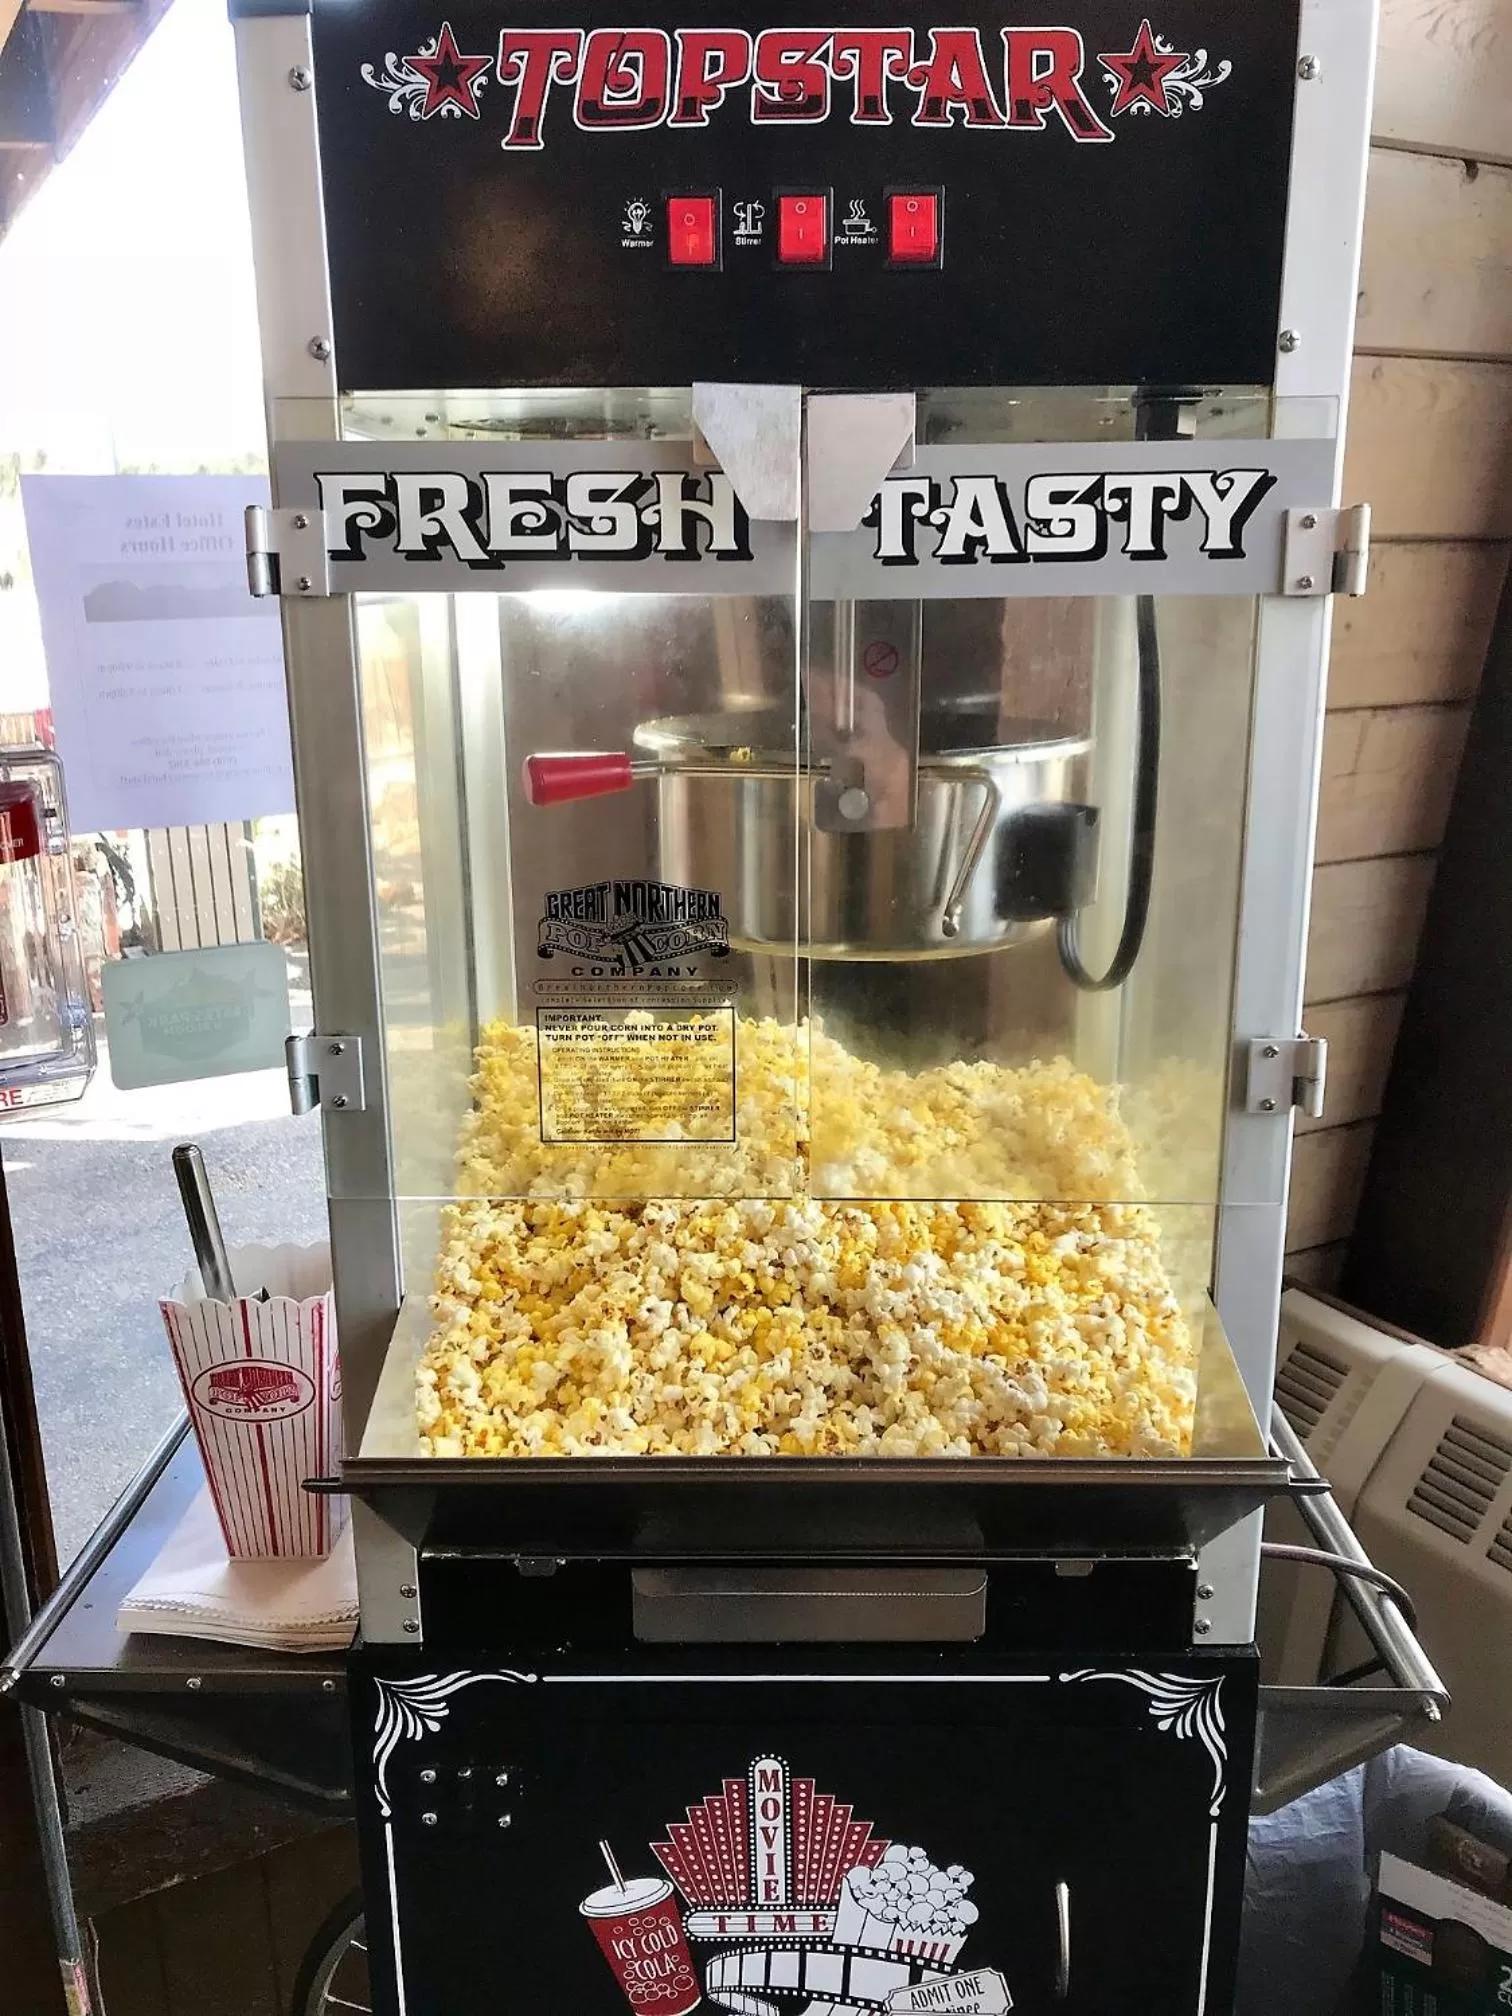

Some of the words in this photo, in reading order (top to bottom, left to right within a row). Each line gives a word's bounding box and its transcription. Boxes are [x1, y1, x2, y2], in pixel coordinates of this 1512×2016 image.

[497, 26, 1116, 151] TOPSTAR
[621, 237, 654, 248] Warmer
[735, 236, 762, 245] Stirrer
[834, 235, 848, 244] Pot
[849, 235, 880, 245] Heater
[313, 471, 754, 569] FRESH
[860, 468, 1277, 565] TASTY
[545, 881, 611, 923] GREAT
[614, 880, 722, 923] NORTHERN
[546, 922, 606, 954] POP
[653, 922, 726, 952] CORN
[570, 966, 699, 977] COMPANY
[545, 1024, 578, 1032] NEVER
[581, 1024, 608, 1032] POUR
[610, 1024, 638, 1032] CORN
[640, 1024, 664, 1032] INTO
[666, 1024, 674, 1032] A
[676, 1024, 696, 1032] DRY
[698, 1024, 719, 1032] POT.
[546, 1033, 573, 1042] TURN
[575, 1033, 595, 1042] POT
[627, 1033, 656, 1042] WHEN
[658, 1033, 679, 1042] NOT
[681, 1033, 692, 1042] IN
[694, 1033, 717, 1042] USE.
[225, 1406, 287, 1414] COMPANY
[757, 1769, 783, 1903] MOVIE
[711, 1913, 830, 1935] TIME
[611, 1937, 638, 1960] ICY
[640, 1924, 679, 1955] COLD
[634, 1952, 677, 1980] COLA
[909, 1983, 952, 2010] ADMIT
[954, 1976, 986, 1999] ONE
